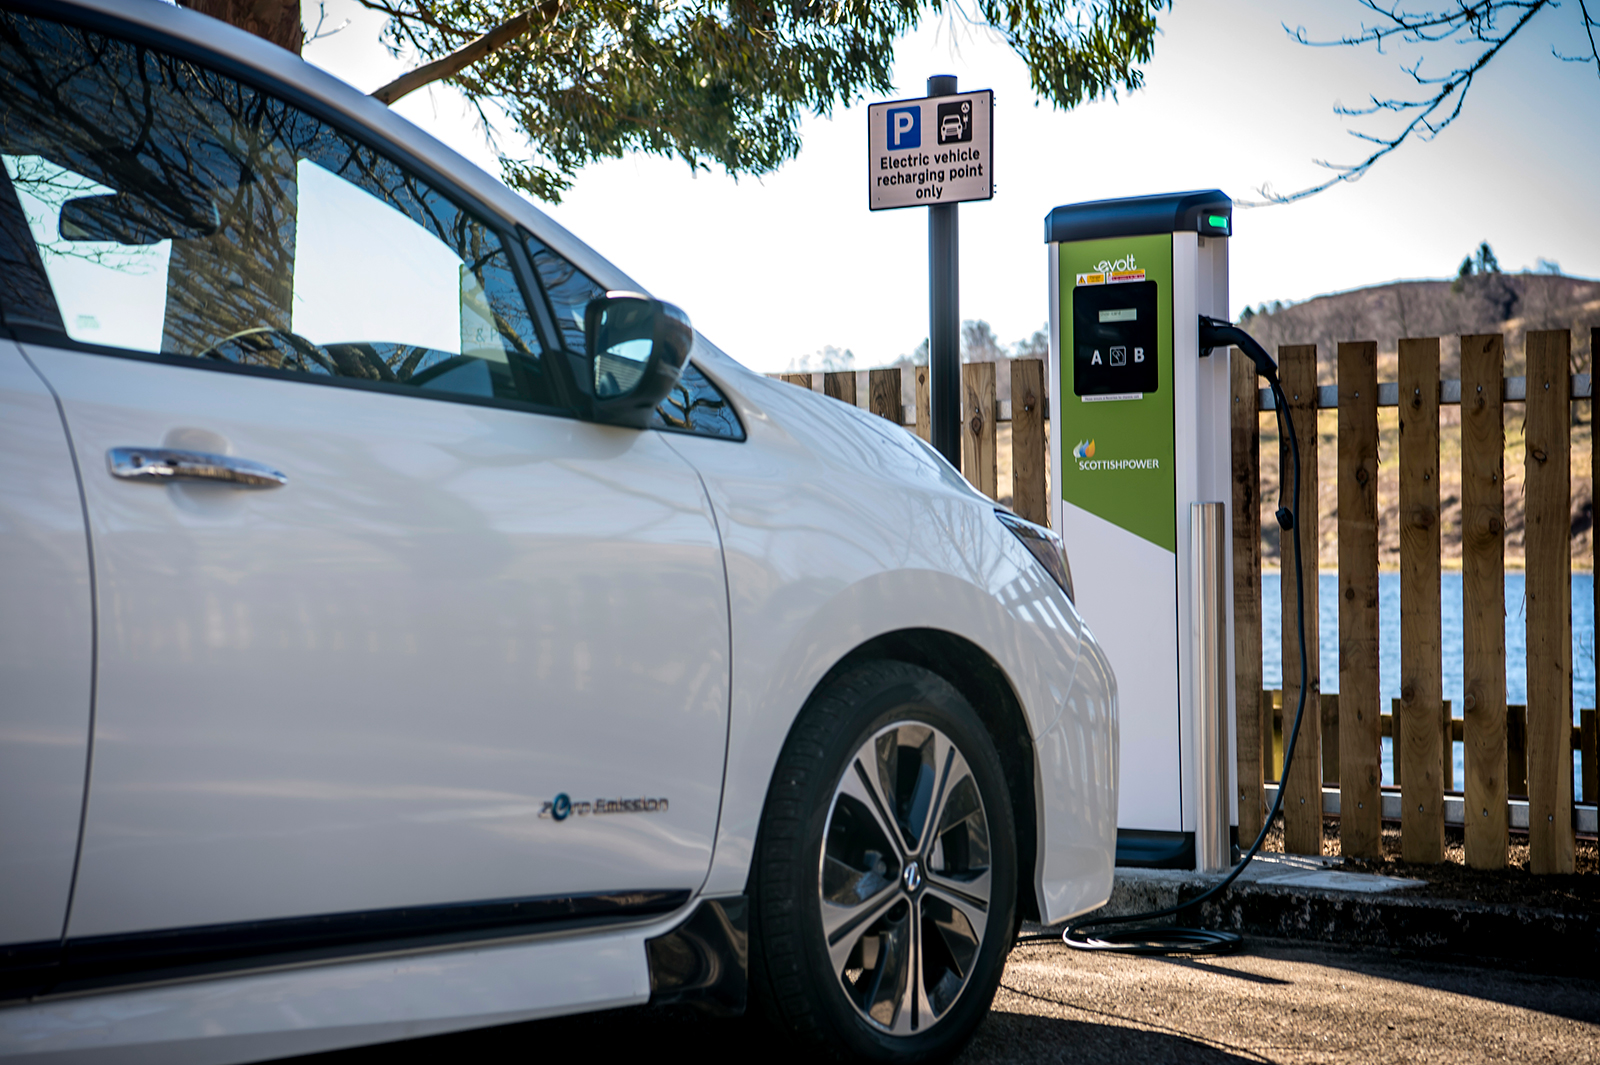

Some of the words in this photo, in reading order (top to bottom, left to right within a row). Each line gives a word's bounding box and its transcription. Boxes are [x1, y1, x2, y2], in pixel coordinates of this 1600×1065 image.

[893, 111, 914, 146] P
[880, 152, 930, 170] Electric
[934, 147, 980, 164] vehicle
[877, 168, 945, 187] recharging
[949, 163, 983, 181] point
[916, 184, 943, 199] only
[1093, 253, 1137, 273] evolt
[1091, 349, 1103, 366] A
[1134, 347, 1145, 363] B
[1079, 458, 1159, 471] SCOTTISHPOWER
[592, 795, 669, 816] Emission
